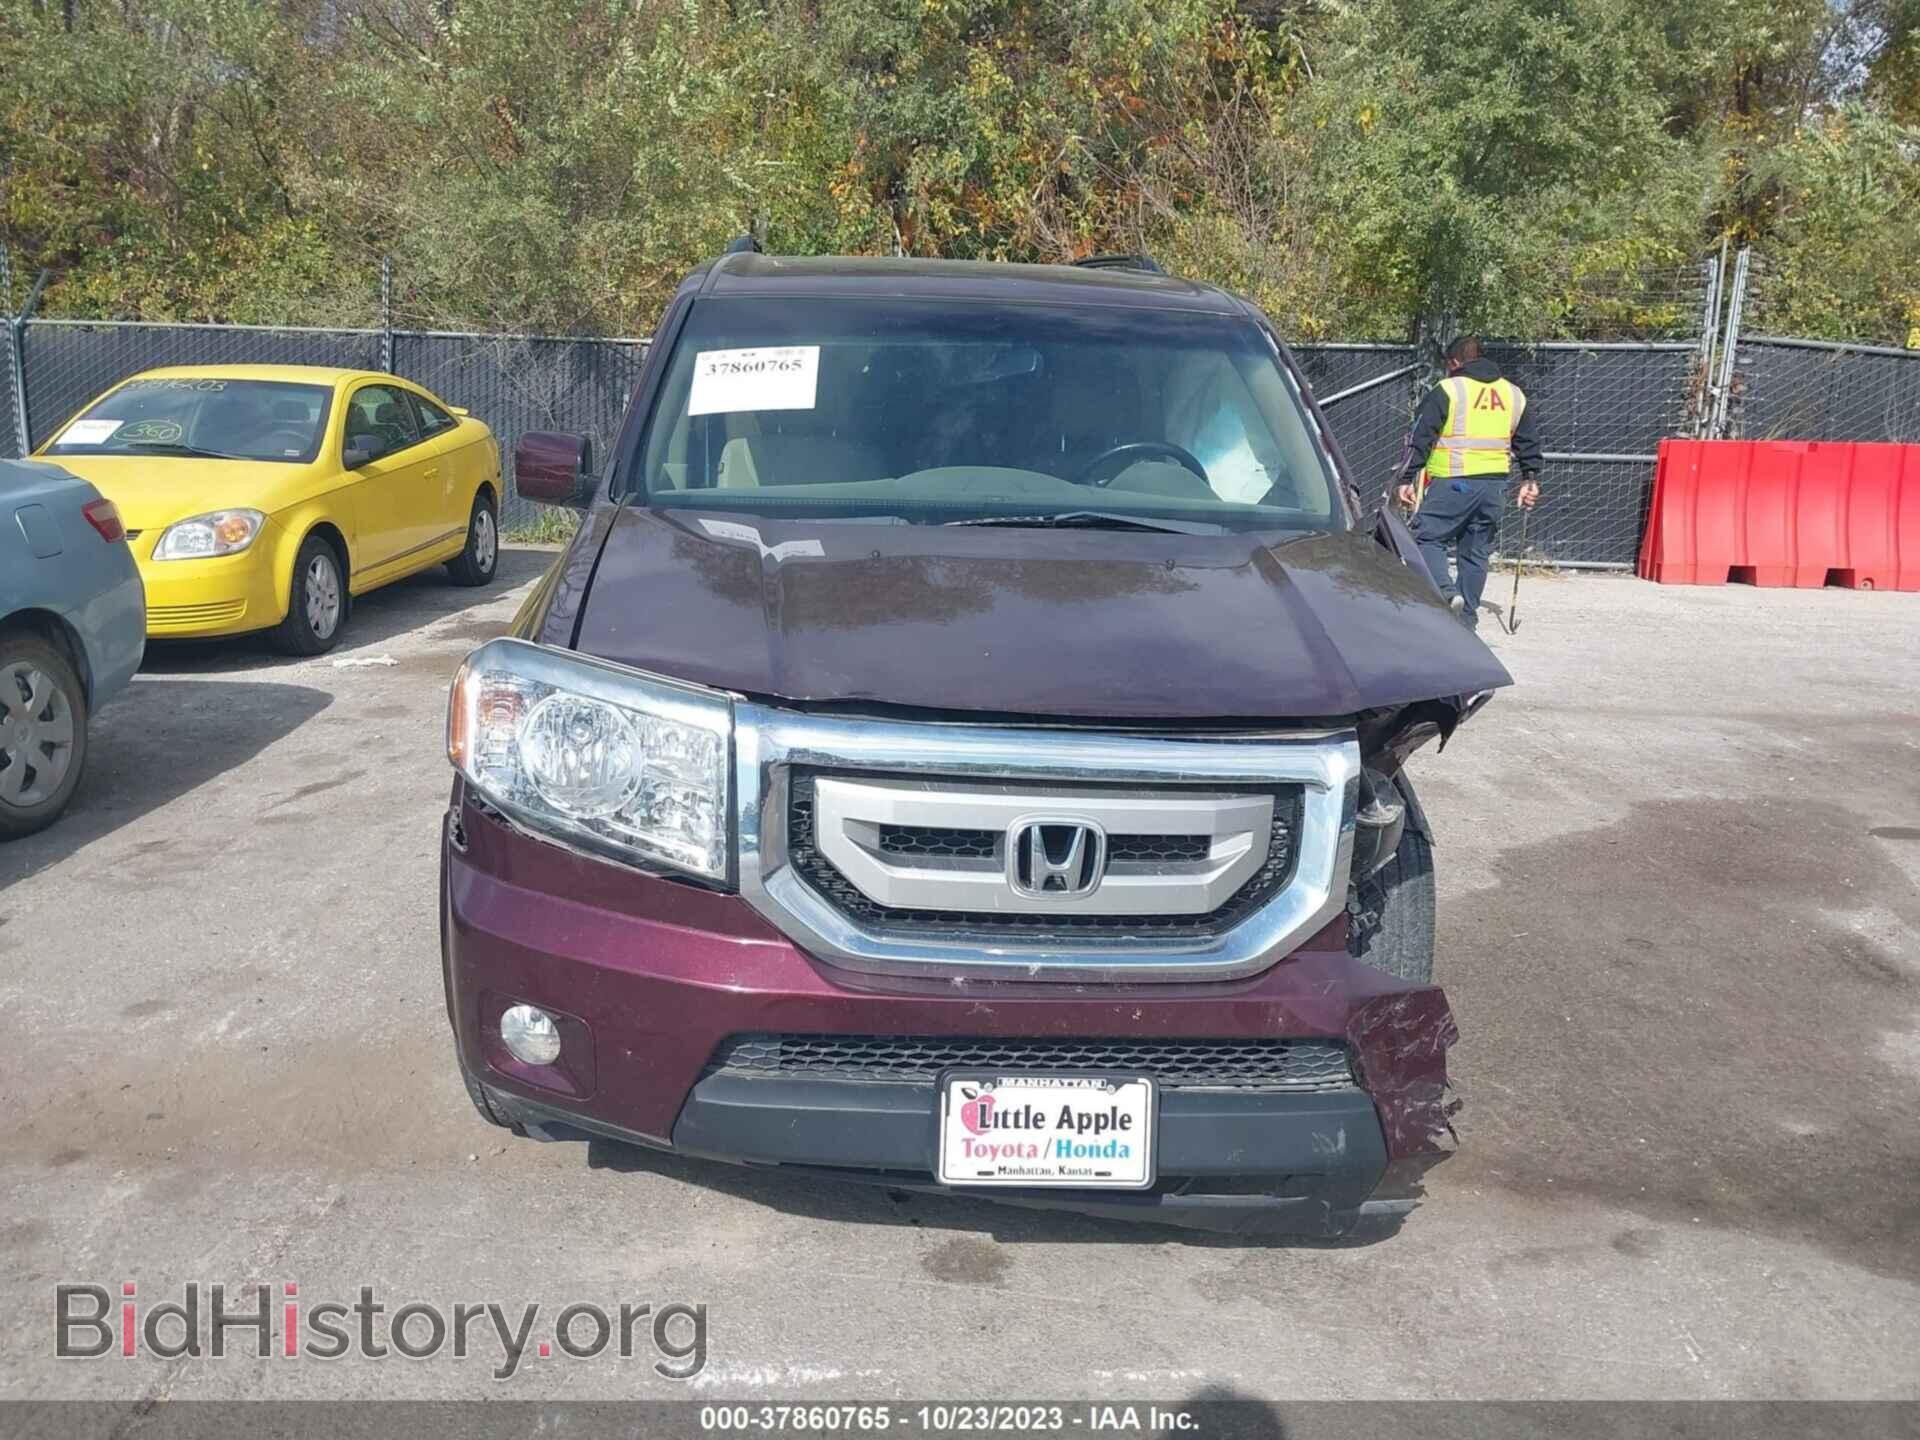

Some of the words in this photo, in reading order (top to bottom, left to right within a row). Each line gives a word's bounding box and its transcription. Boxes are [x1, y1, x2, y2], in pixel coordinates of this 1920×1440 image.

[705, 359, 802, 376] 37860765
[978, 1103, 1045, 1130] Little
[1056, 1105, 1132, 1135] Apple
[998, 1165, 1055, 1177] Manhattan,
[1059, 1165, 1093, 1176] Kansas
